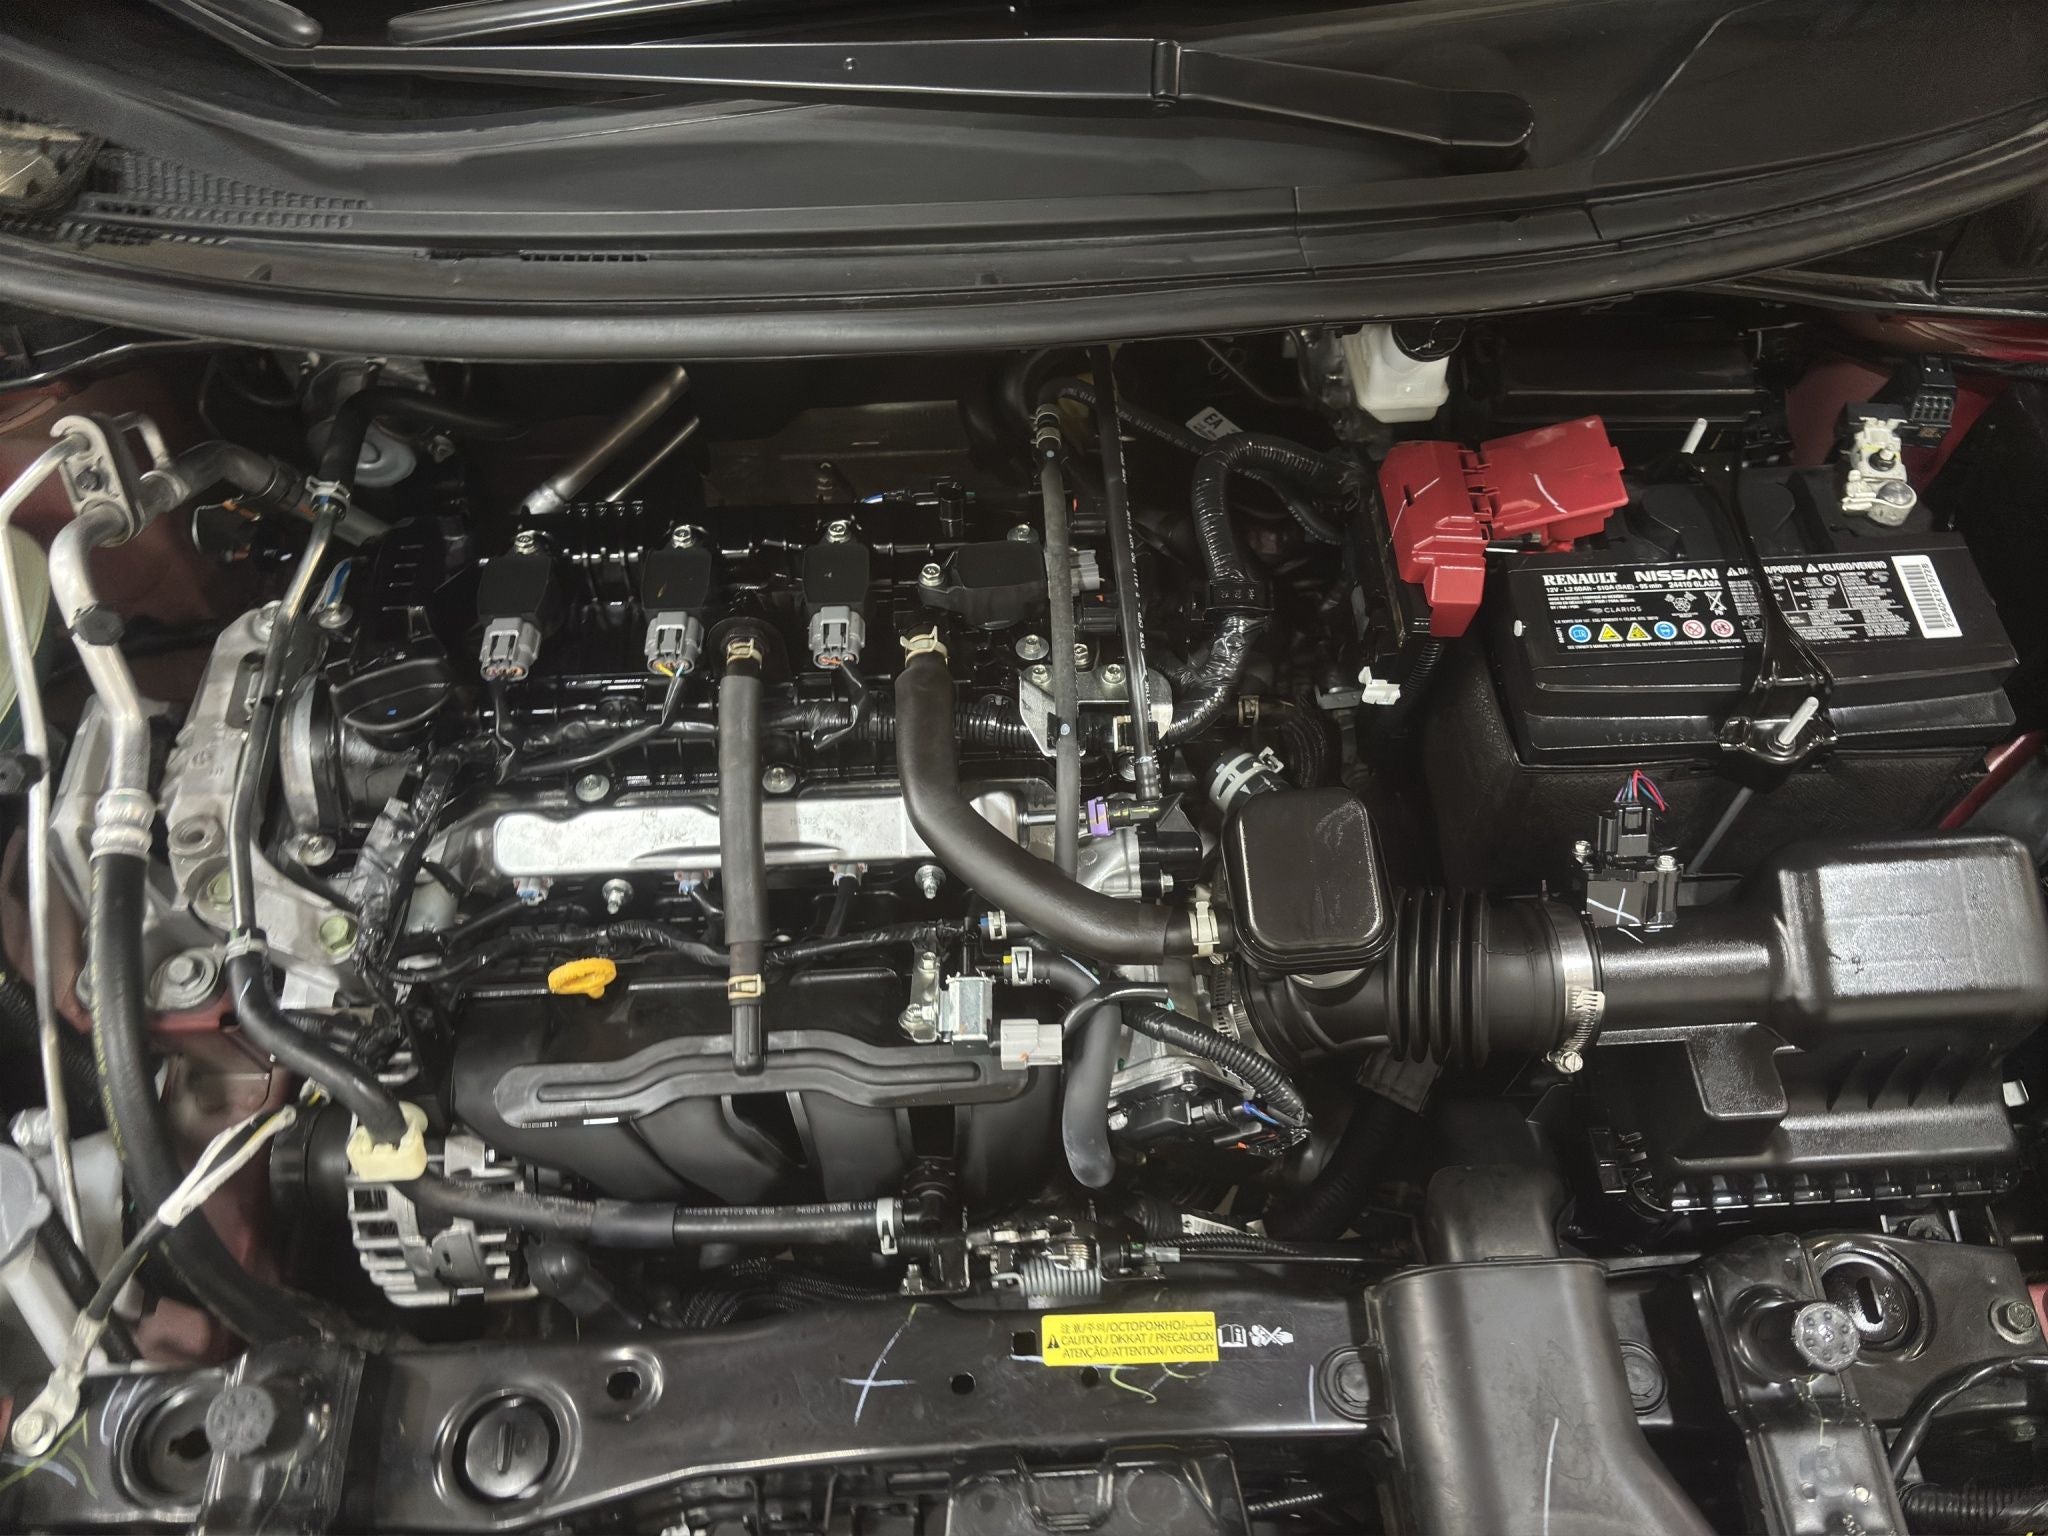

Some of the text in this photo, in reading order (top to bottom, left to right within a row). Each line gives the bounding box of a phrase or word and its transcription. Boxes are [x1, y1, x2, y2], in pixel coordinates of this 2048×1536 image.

[1542, 568, 1719, 586] RENAULT NISSAN
[1604, 605, 1642, 613] CLARIOS
[1061, 1335, 1103, 1346] CAUTION
[1110, 1333, 1148, 1344] DIKKAT
